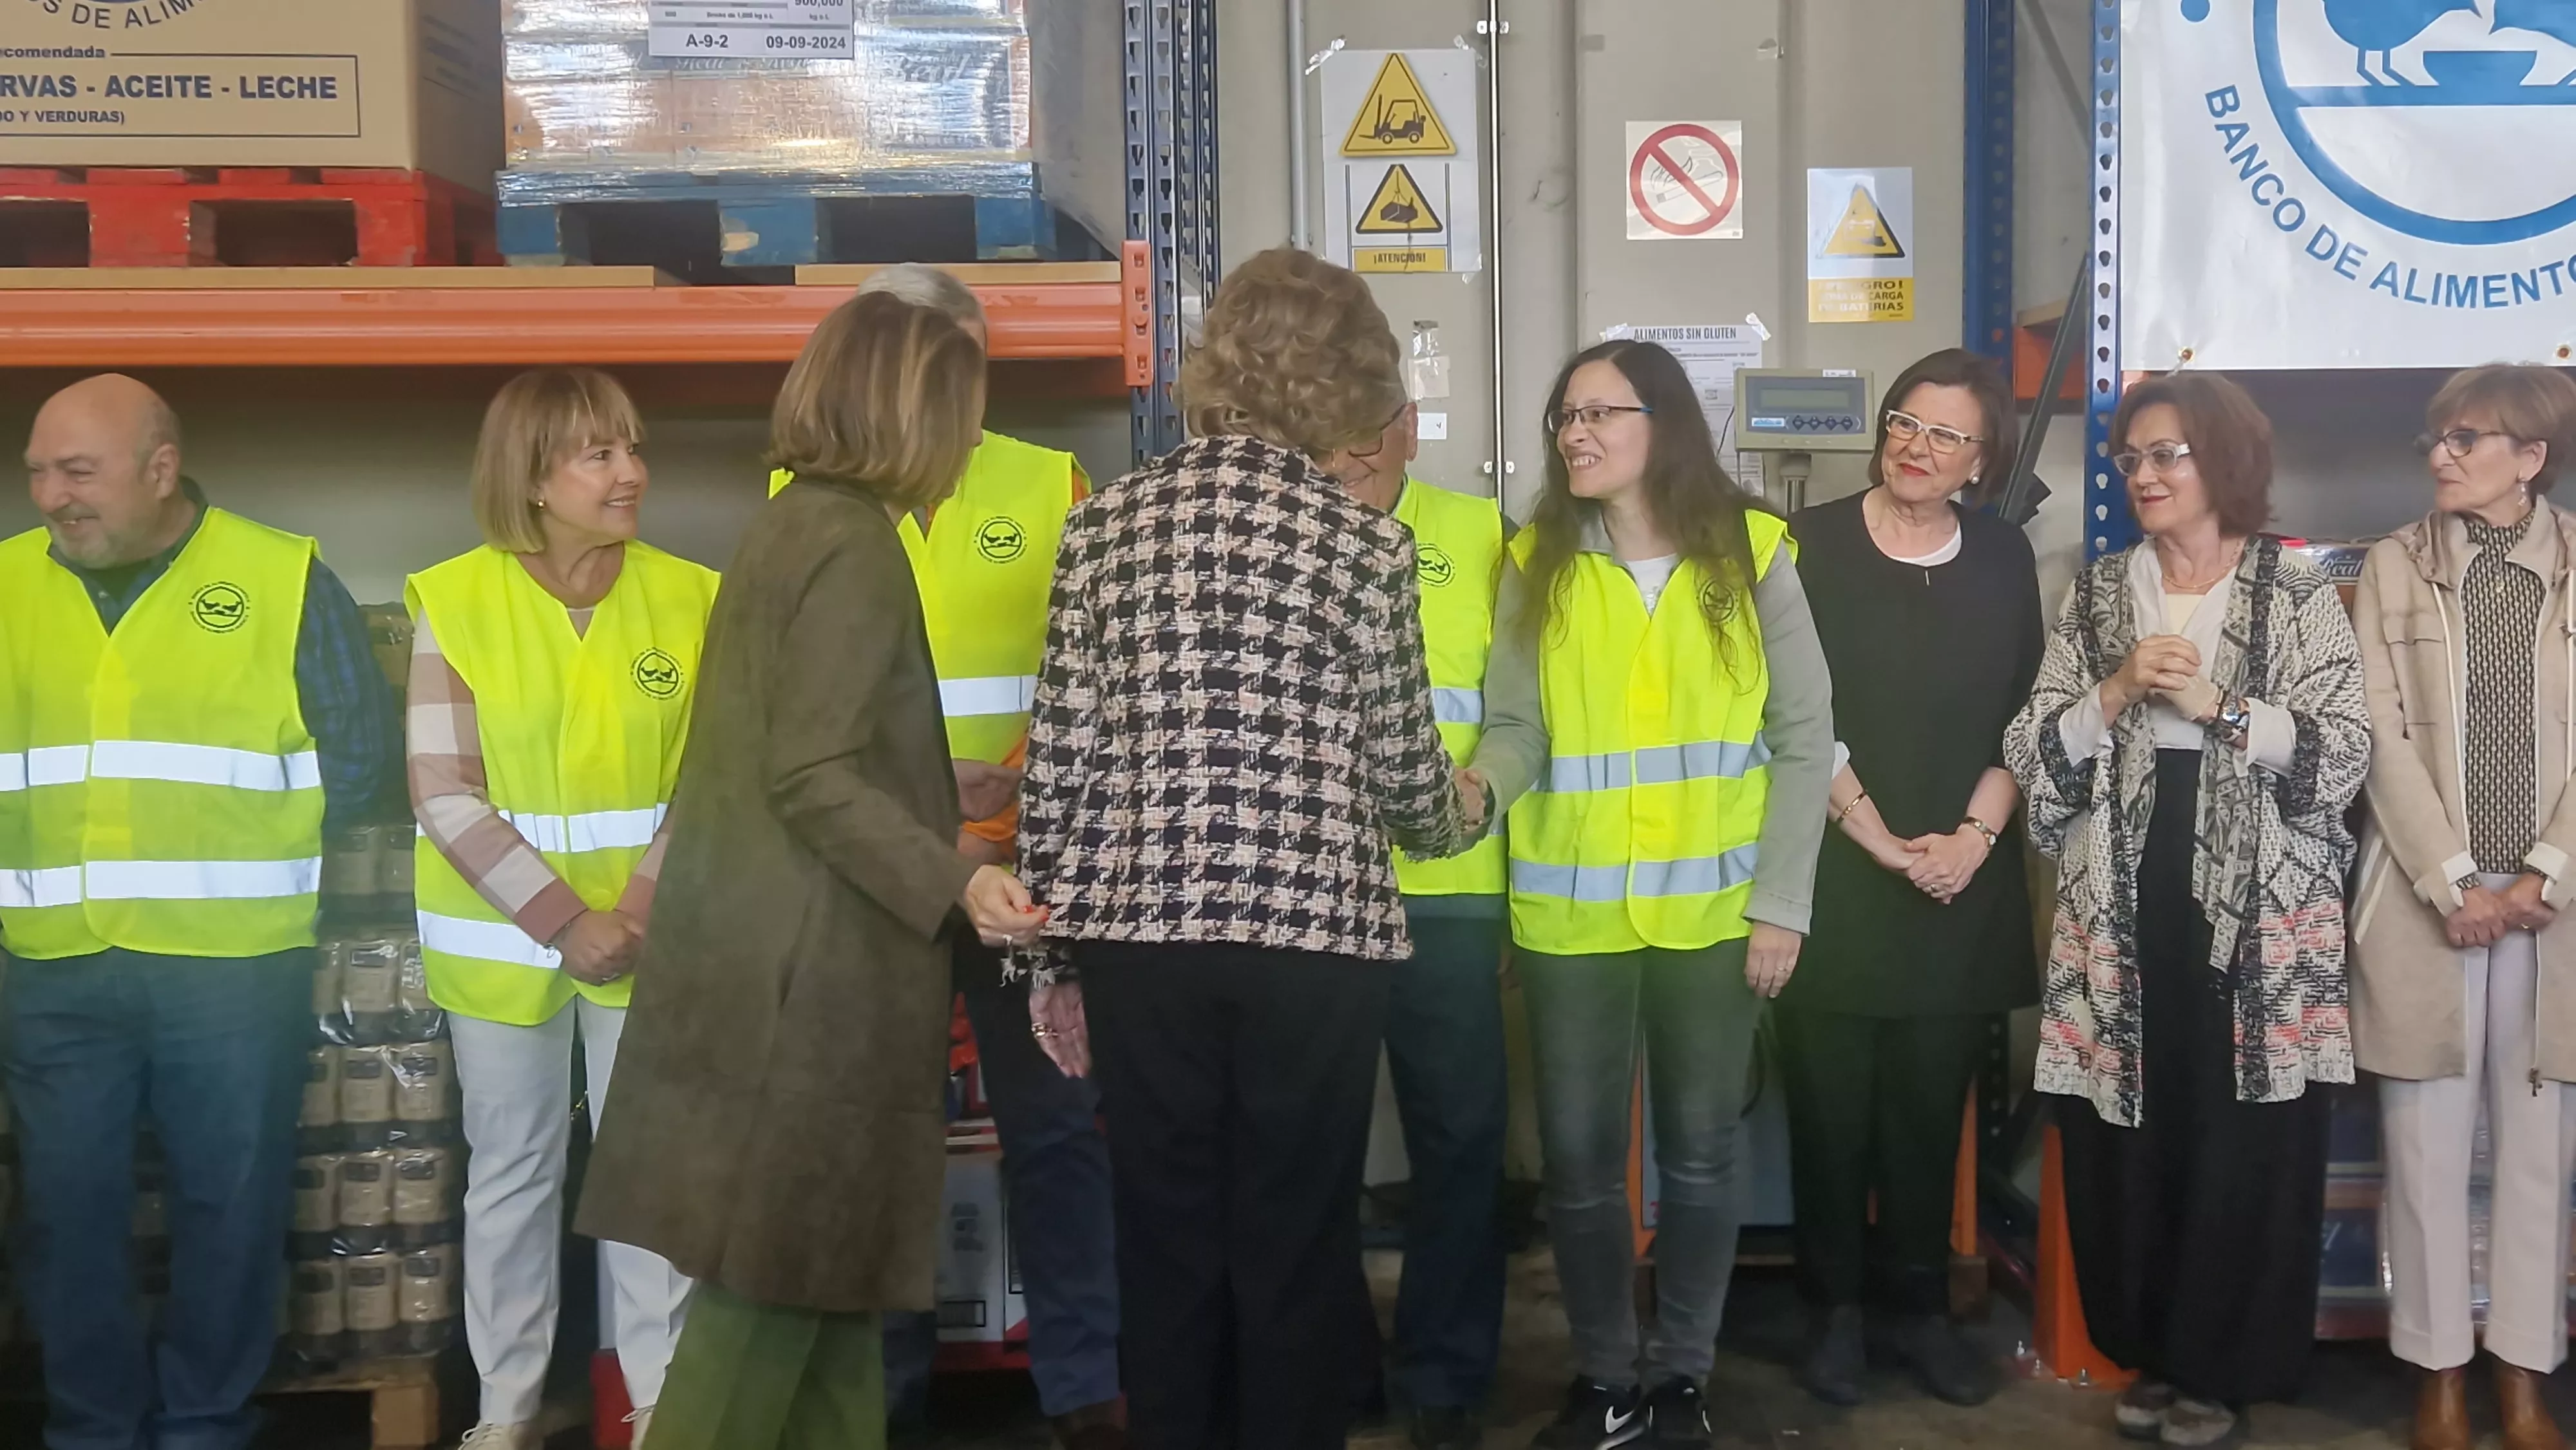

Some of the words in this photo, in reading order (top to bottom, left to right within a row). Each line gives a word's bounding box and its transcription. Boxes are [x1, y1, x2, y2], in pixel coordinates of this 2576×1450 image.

[71, 3, 111, 28] DE
[124, 0, 204, 28] ALIM
[686, 33, 728, 48] A-9-2
[766, 35, 846, 49] 09-09-2024
[104, 75, 212, 99] ACEITE
[240, 75, 337, 99] LECHE
[20, 110, 30, 122] Y
[35, 110, 125, 126] VERDURAS)
[2204, 84, 2306, 232] BANCO
[2304, 223, 2369, 281] DE
[1869, 291, 1904, 301] CARGA
[1634, 328, 1684, 341] ALIMENTOS
[1686, 327, 1701, 340] SIN
